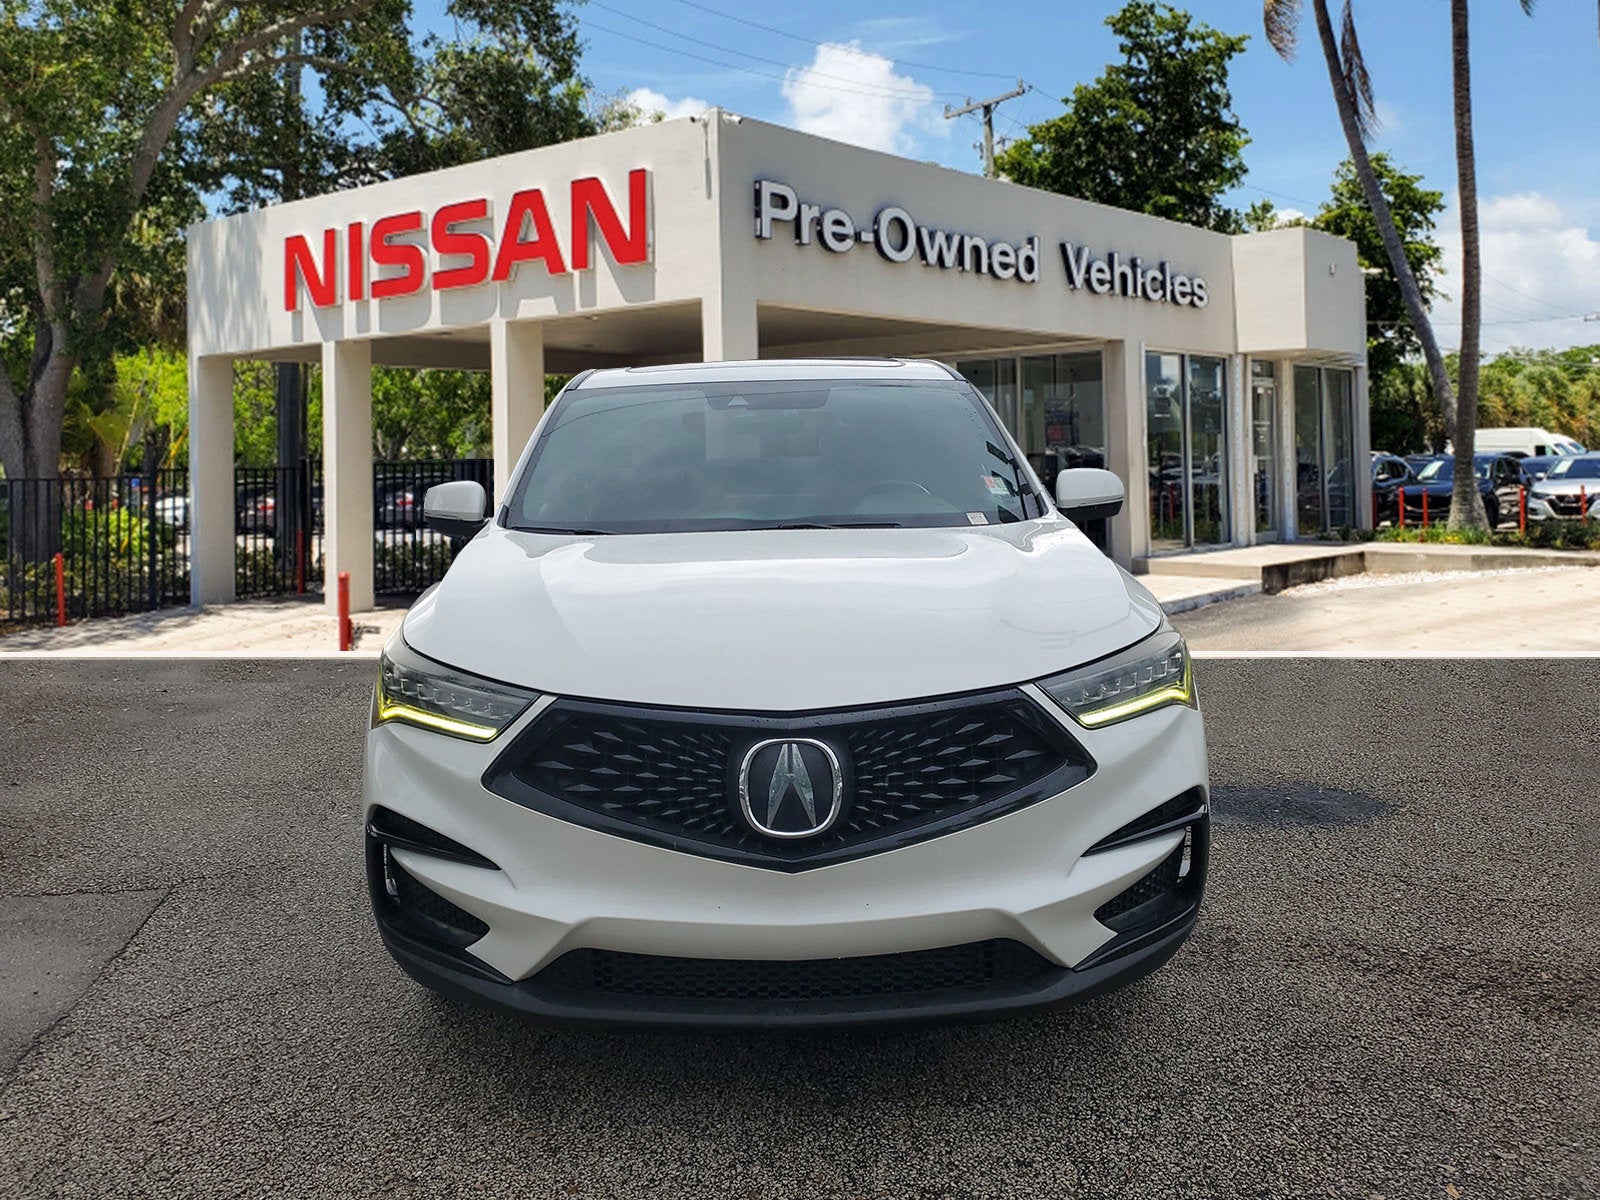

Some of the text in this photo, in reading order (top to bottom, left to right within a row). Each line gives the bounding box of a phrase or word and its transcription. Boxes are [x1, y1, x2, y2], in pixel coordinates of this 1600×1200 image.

[284, 168, 648, 312] NISSAN
[754, 179, 1209, 308] Pre-Owned Vehicles
